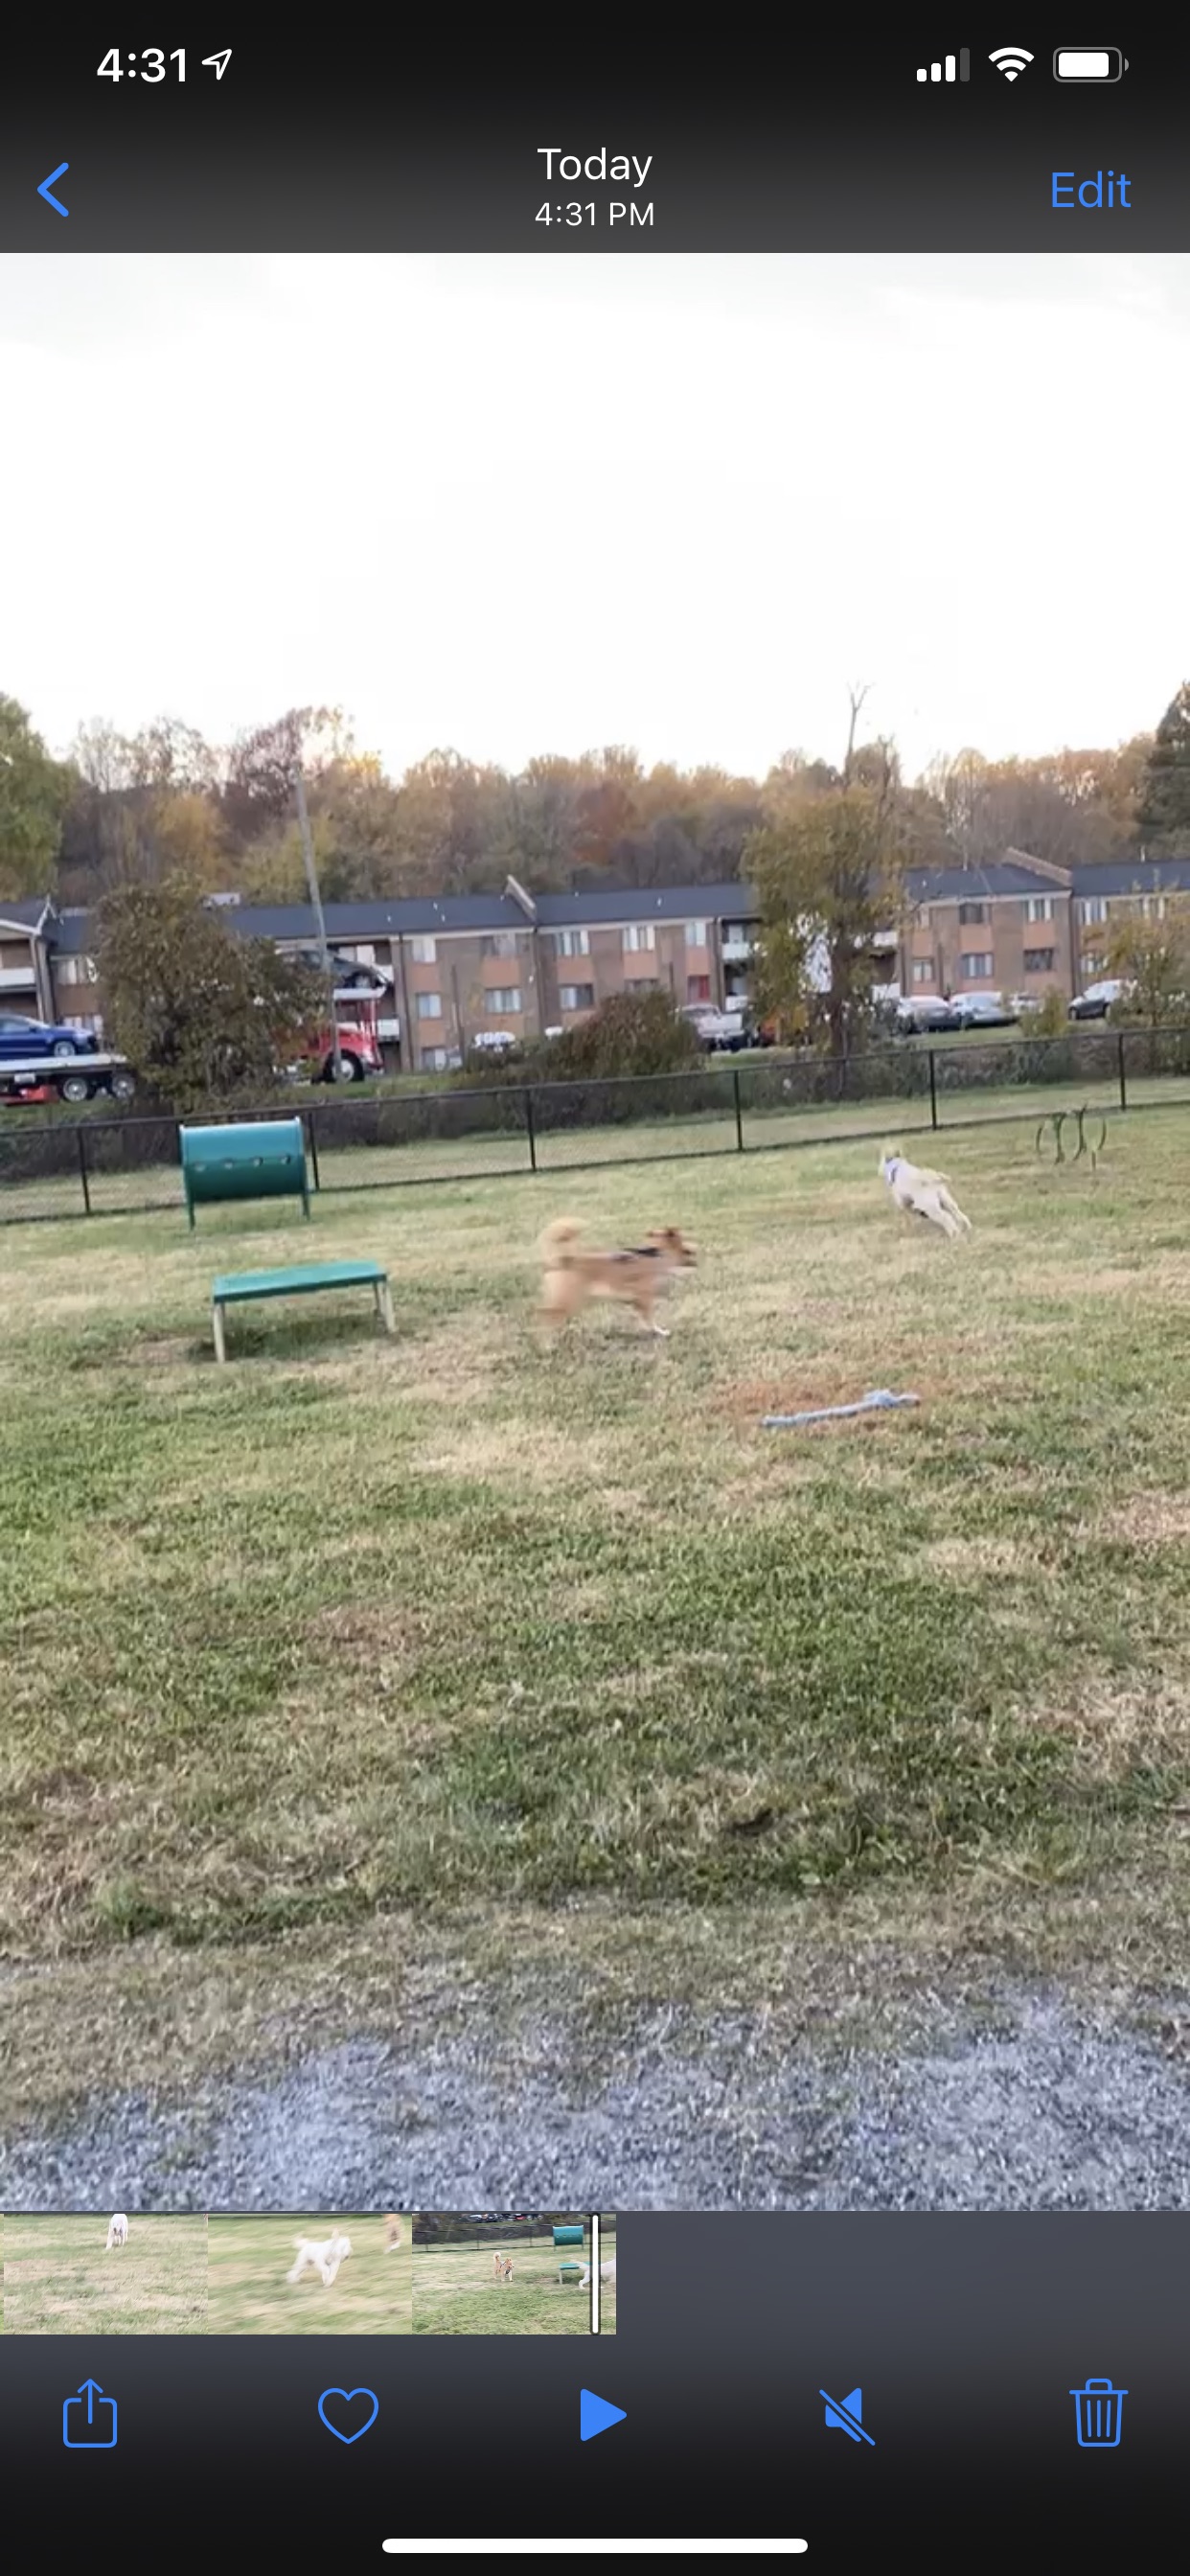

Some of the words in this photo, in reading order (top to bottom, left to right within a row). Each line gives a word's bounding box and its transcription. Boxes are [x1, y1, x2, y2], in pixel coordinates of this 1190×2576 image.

[97, 47, 189, 83] 4:31
[537, 147, 653, 189] Today
[1050, 170, 1133, 209] Edit
[535, 201, 595, 227] 4:31
[609, 201, 655, 226] PM
